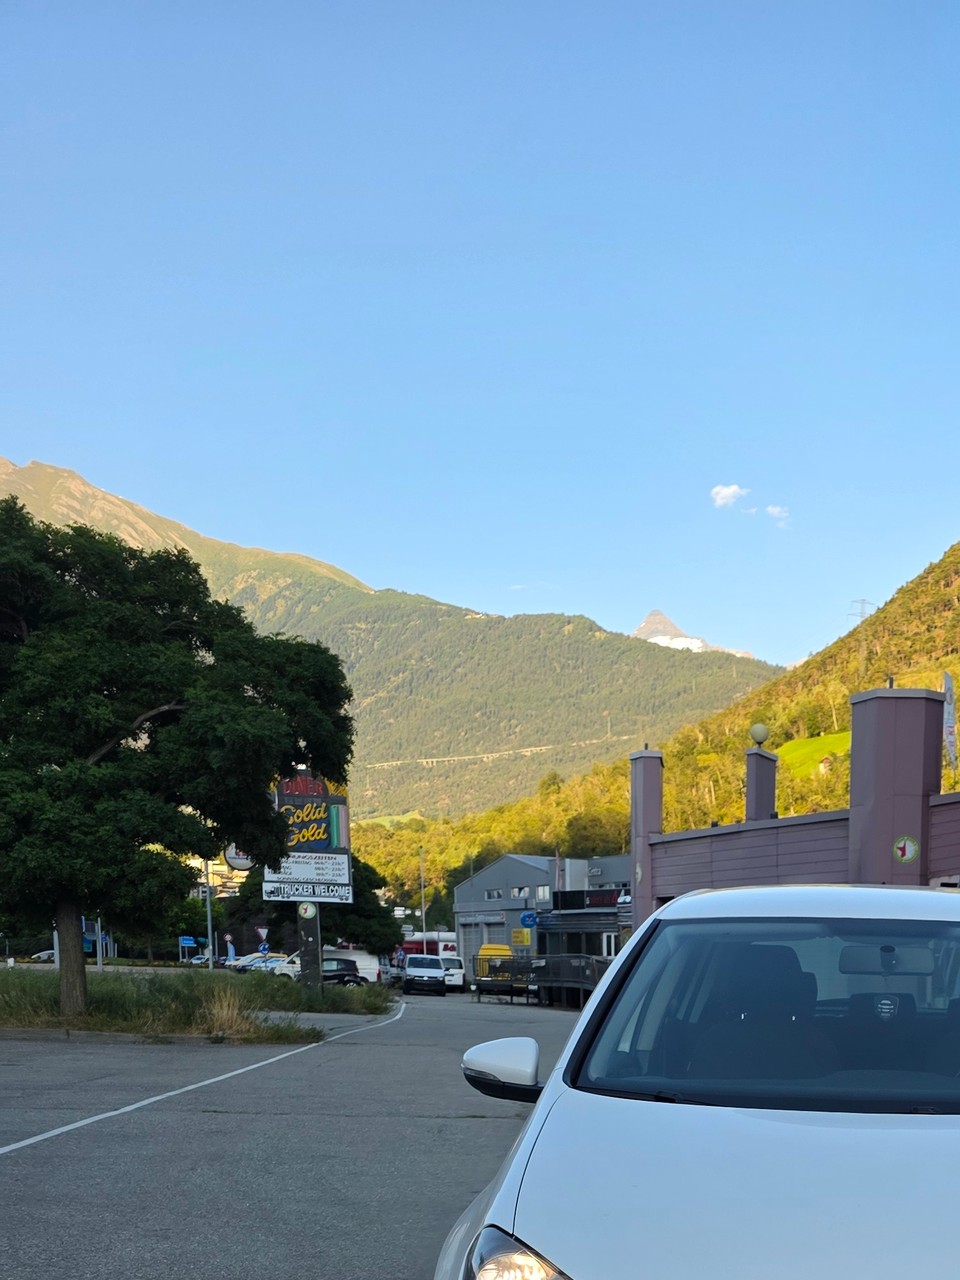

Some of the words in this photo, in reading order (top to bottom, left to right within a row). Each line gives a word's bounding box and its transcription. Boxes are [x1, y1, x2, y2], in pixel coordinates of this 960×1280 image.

[282, 777, 324, 796] DINER
[279, 884, 314, 896] TRUCKER
[314, 885, 350, 896] WELCOME
